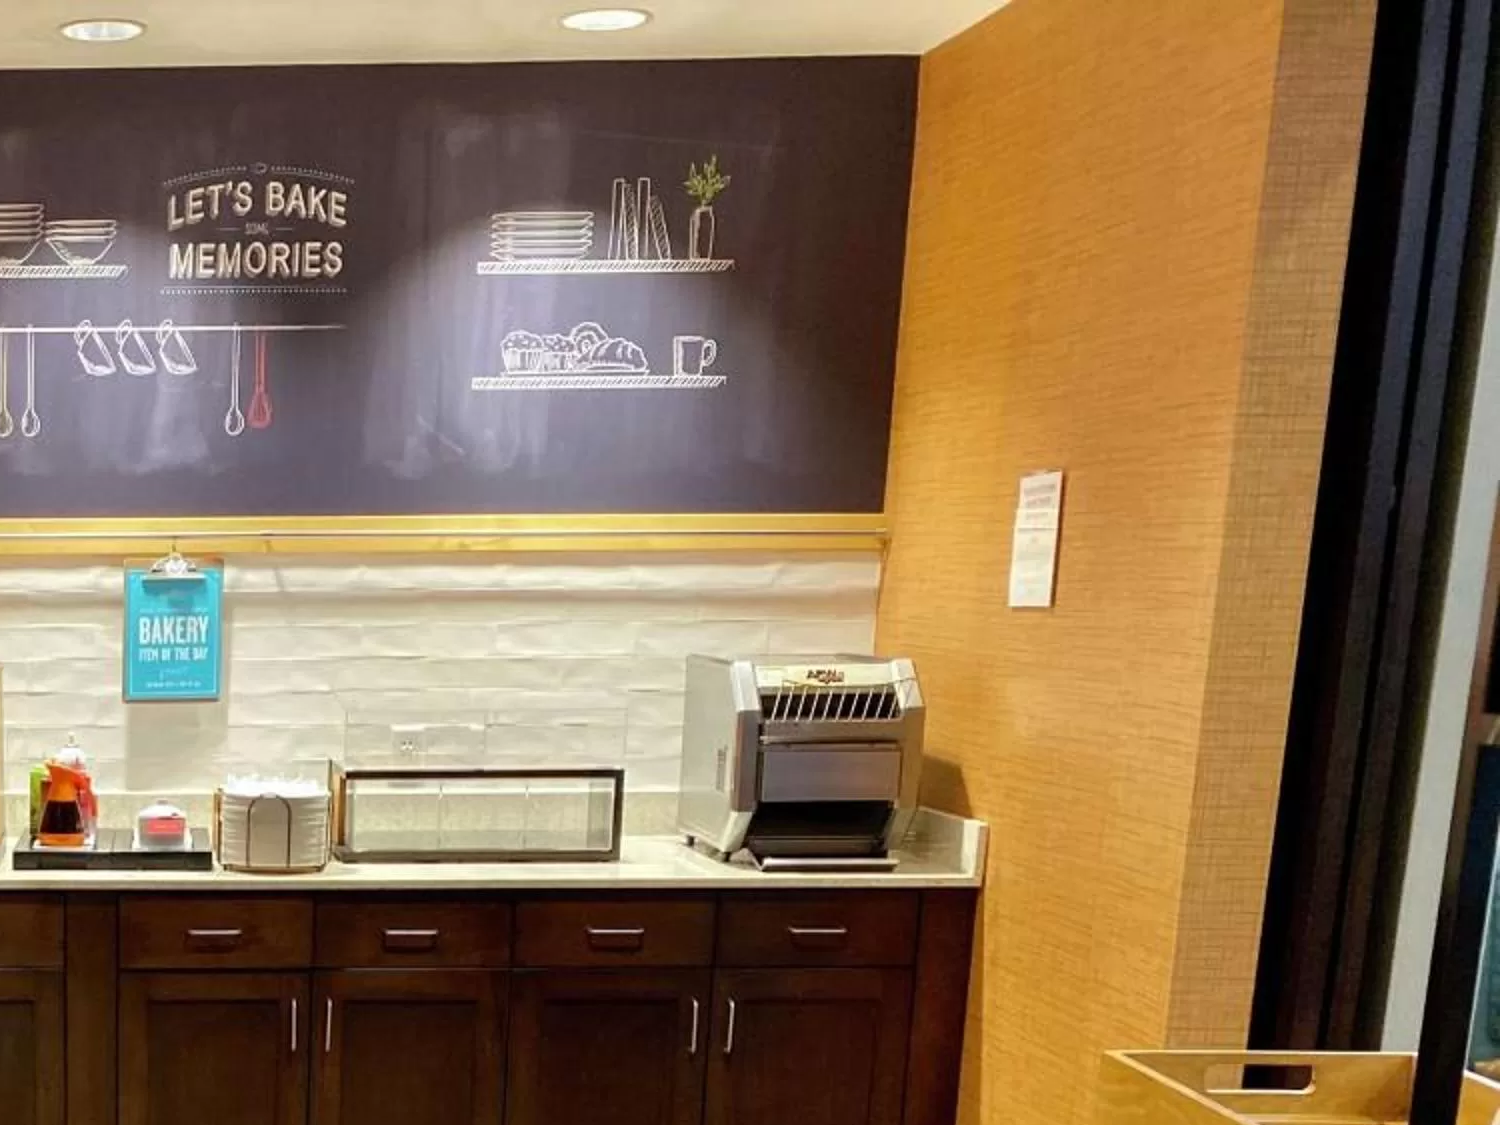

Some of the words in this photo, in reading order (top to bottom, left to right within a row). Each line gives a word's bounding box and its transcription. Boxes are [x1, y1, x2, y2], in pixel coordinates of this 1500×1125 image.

[168, 180, 253, 231] LET'S
[265, 181, 348, 227] BAKE
[169, 241, 343, 279] MEMORIES
[138, 615, 209, 645] BAKERY
